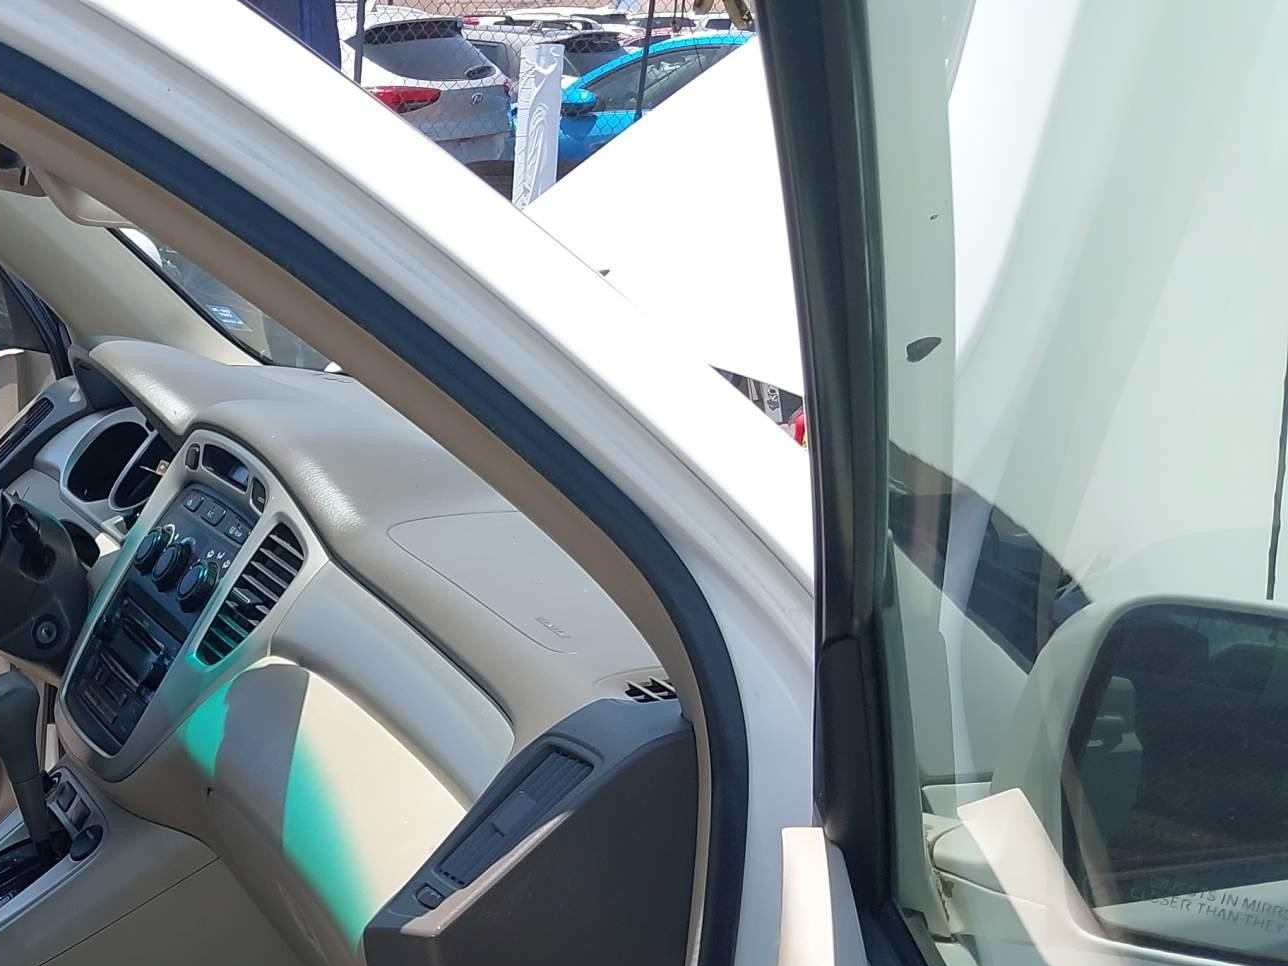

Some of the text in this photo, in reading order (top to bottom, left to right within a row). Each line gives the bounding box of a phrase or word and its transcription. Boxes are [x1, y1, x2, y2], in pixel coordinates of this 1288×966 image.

[1221, 893, 1239, 907] IN
[1197, 903, 1241, 924] THAN
[1243, 913, 1286, 933] THEY
